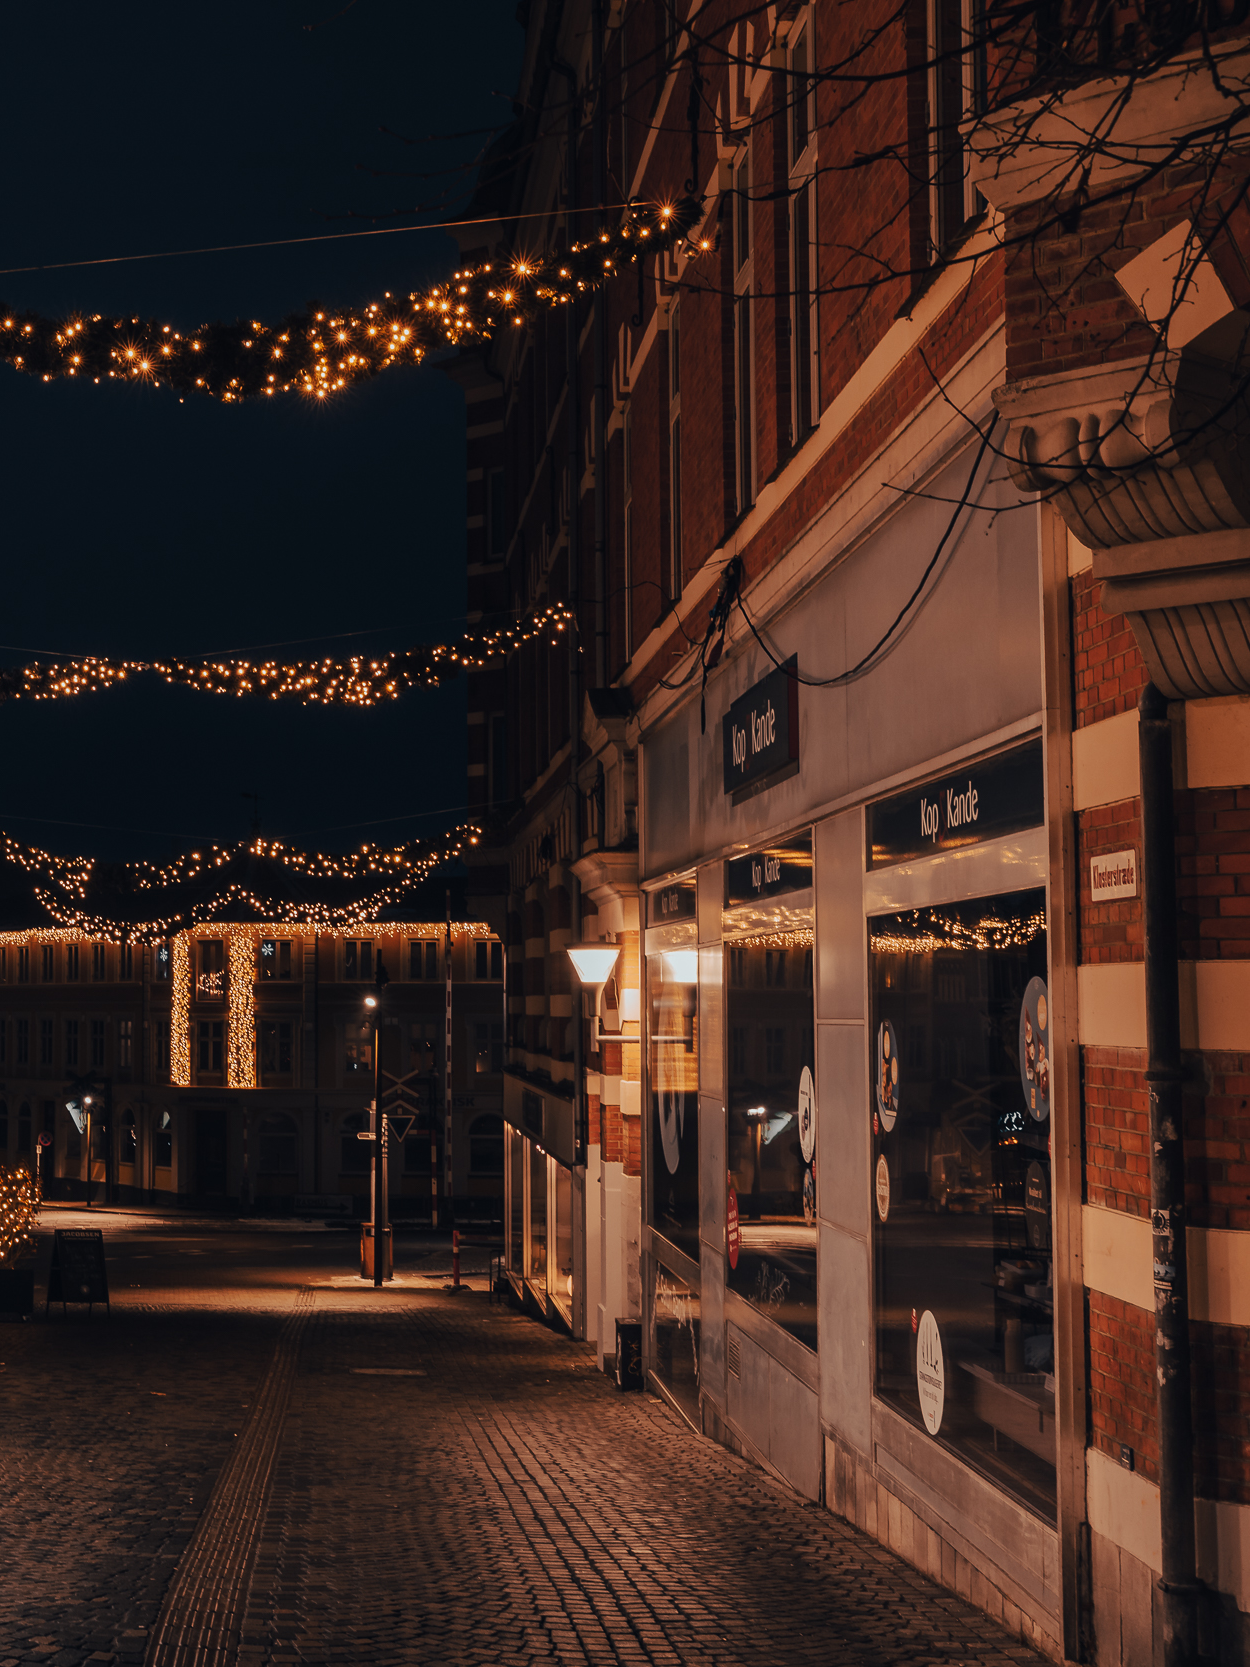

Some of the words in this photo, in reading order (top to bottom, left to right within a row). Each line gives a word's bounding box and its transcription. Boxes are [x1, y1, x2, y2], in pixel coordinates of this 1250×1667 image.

[732, 724, 746, 773] Kop
[751, 699, 776, 754] Kande
[921, 798, 939, 843] Kop
[947, 780, 979, 828] Kande
[752, 860, 762, 893] Kop
[764, 853, 781, 884] Kande
